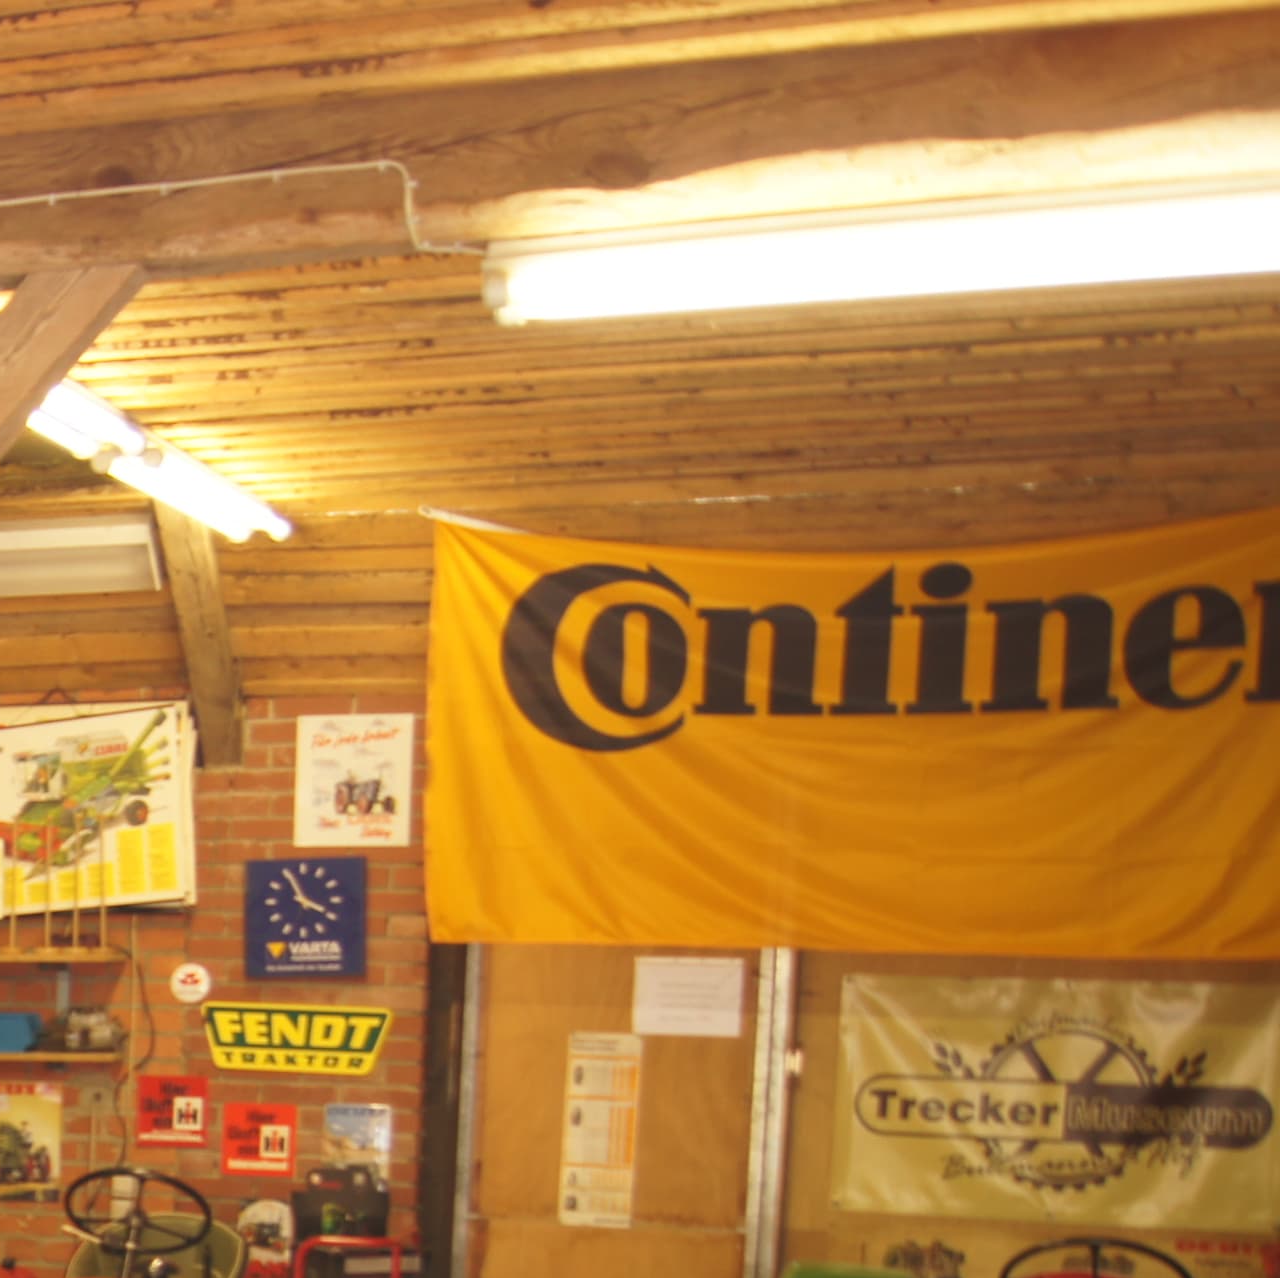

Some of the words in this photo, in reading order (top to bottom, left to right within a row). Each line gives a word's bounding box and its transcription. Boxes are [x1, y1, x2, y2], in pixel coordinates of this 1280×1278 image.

[501, 563, 1280, 752] Contine
[289, 940, 343, 955] VARTA
[212, 1010, 383, 1050] FENDT
[221, 1051, 365, 1069] TRAKTOR
[870, 1088, 1059, 1126] Trecker
